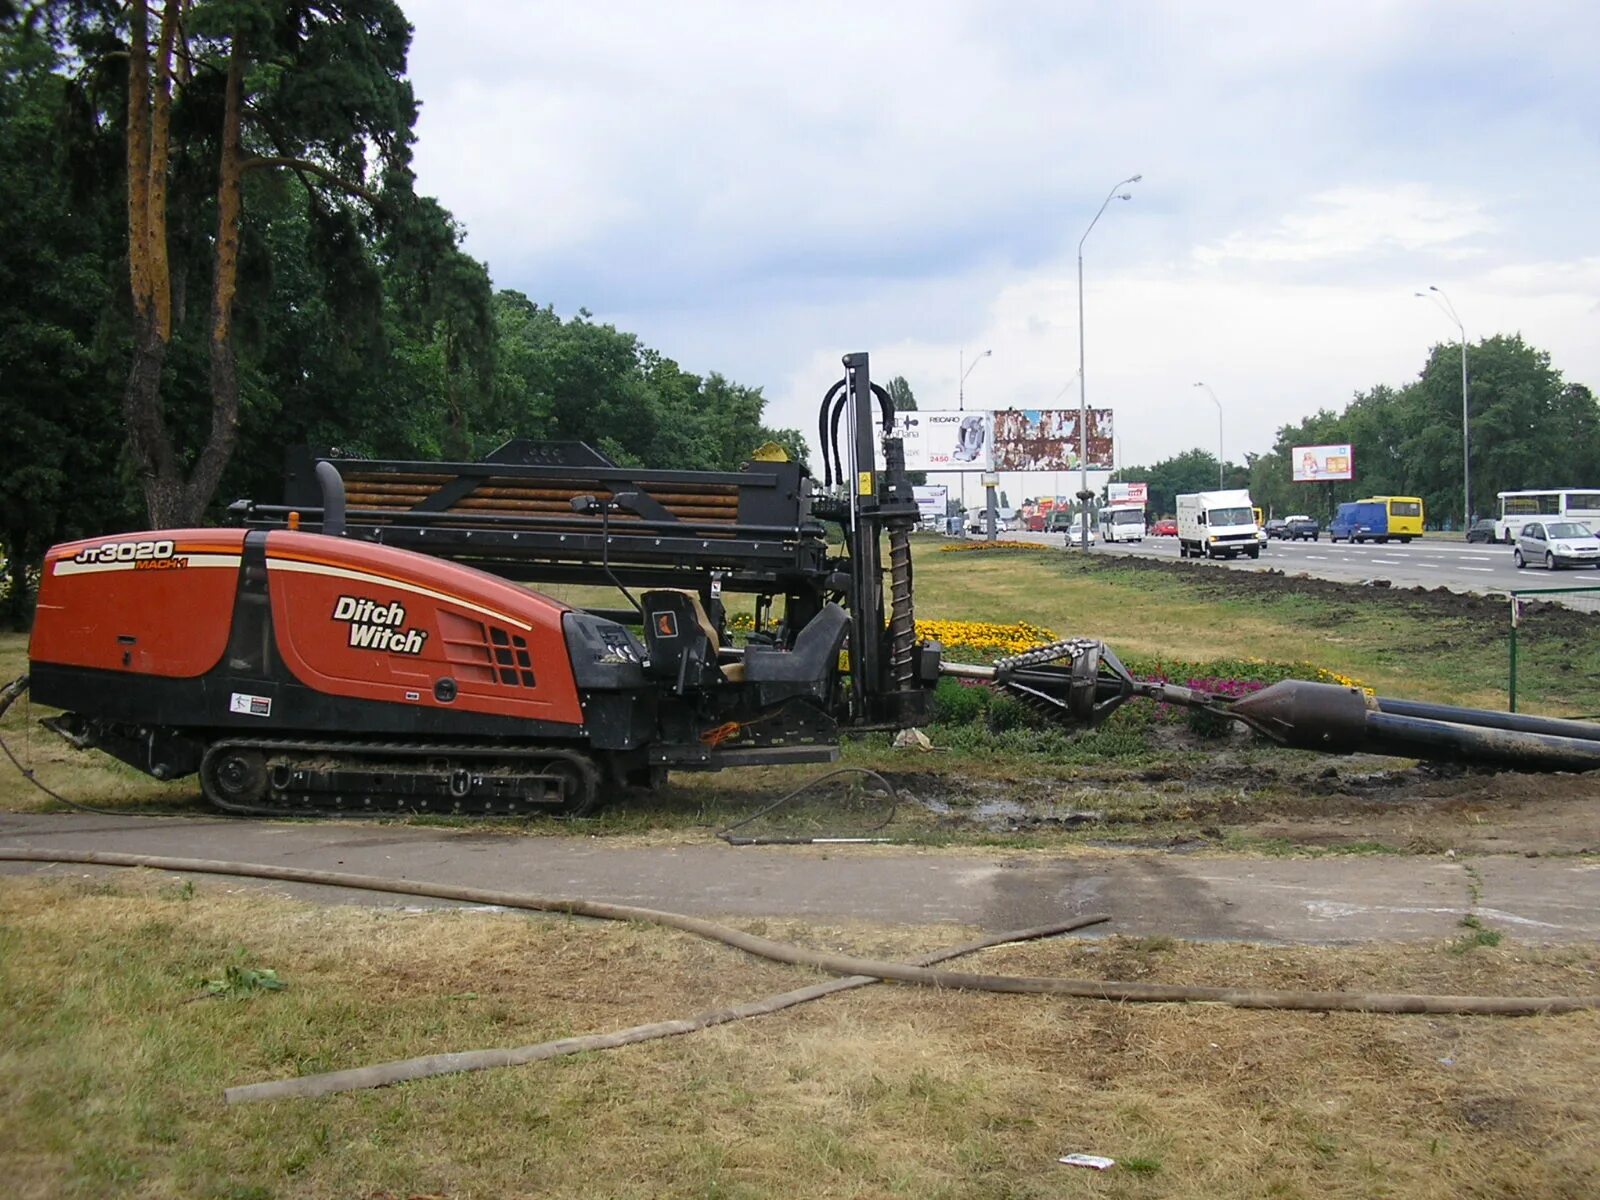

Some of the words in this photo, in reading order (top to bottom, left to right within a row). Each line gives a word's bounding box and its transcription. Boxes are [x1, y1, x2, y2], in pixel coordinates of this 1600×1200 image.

[929, 416, 960, 424] RECARO
[75, 540, 174, 563] JT3020
[135, 559, 177, 570] MACH
[333, 596, 405, 626] Ditch
[349, 623, 424, 653] Witch
